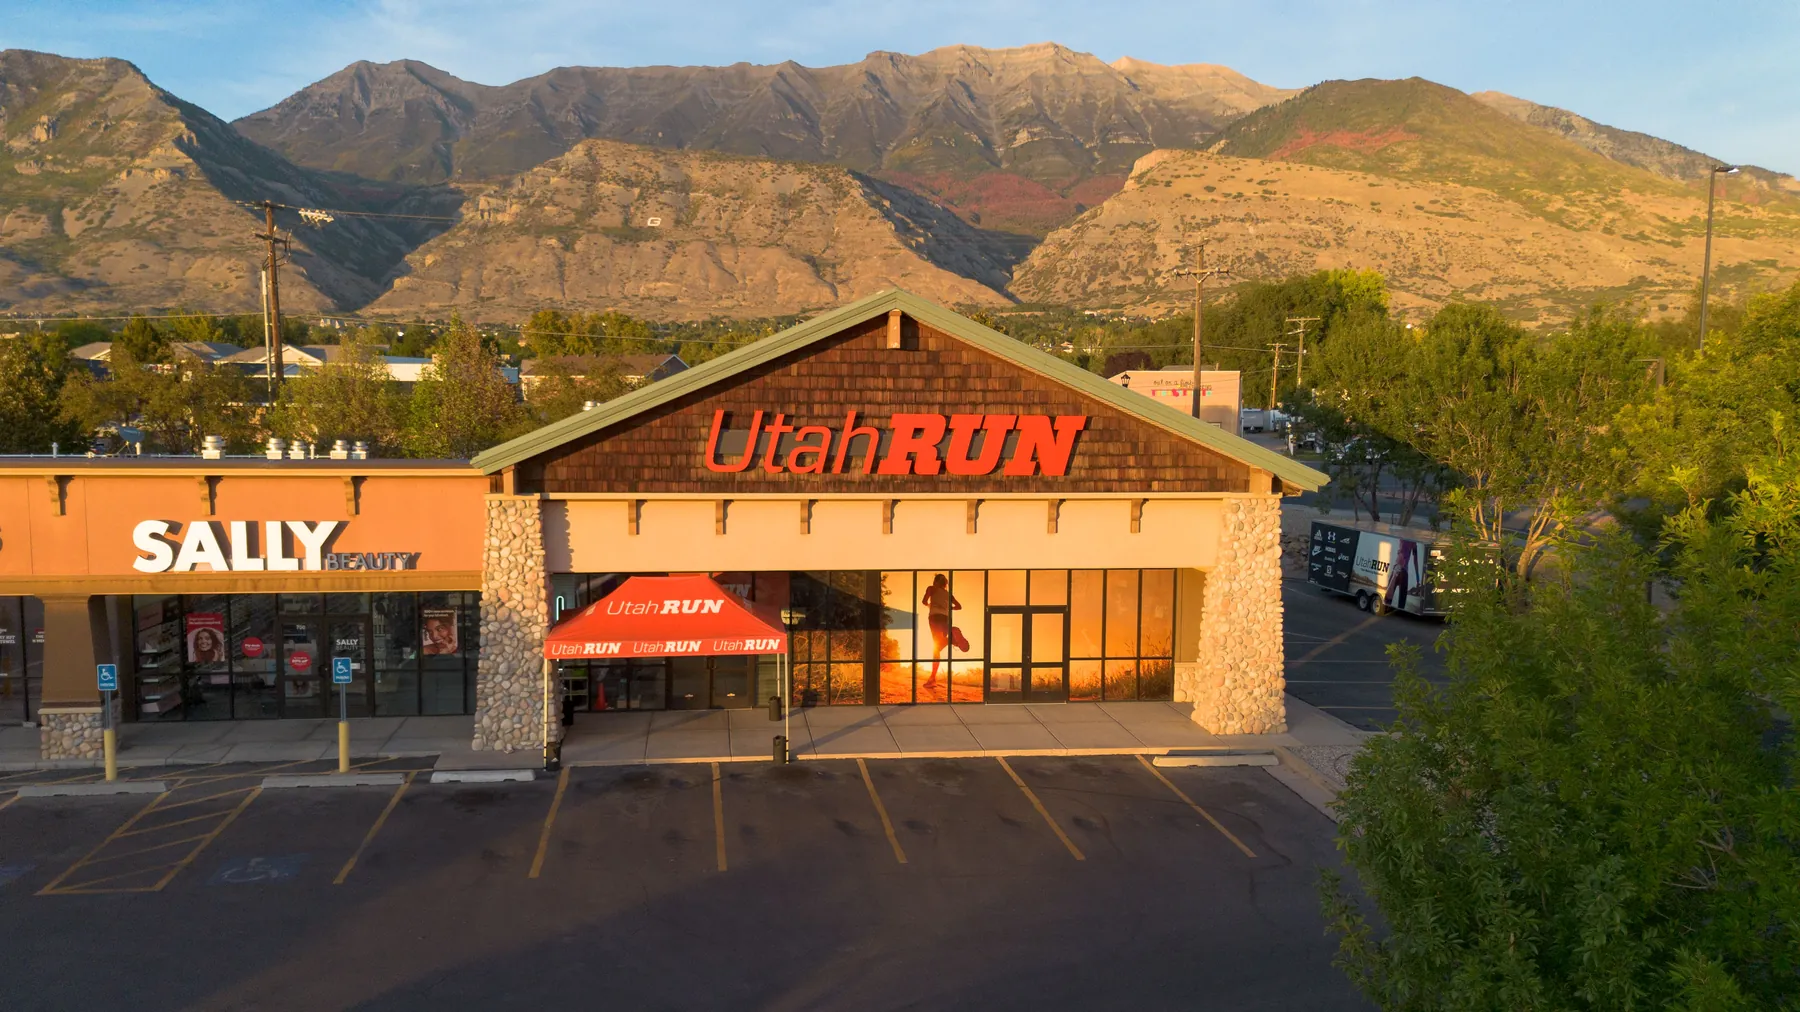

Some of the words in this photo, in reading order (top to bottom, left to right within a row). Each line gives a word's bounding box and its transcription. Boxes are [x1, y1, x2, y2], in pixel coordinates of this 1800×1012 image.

[647, 217, 662, 227] G
[132, 519, 339, 573] SALLY
[326, 552, 412, 571] BEAUTY
